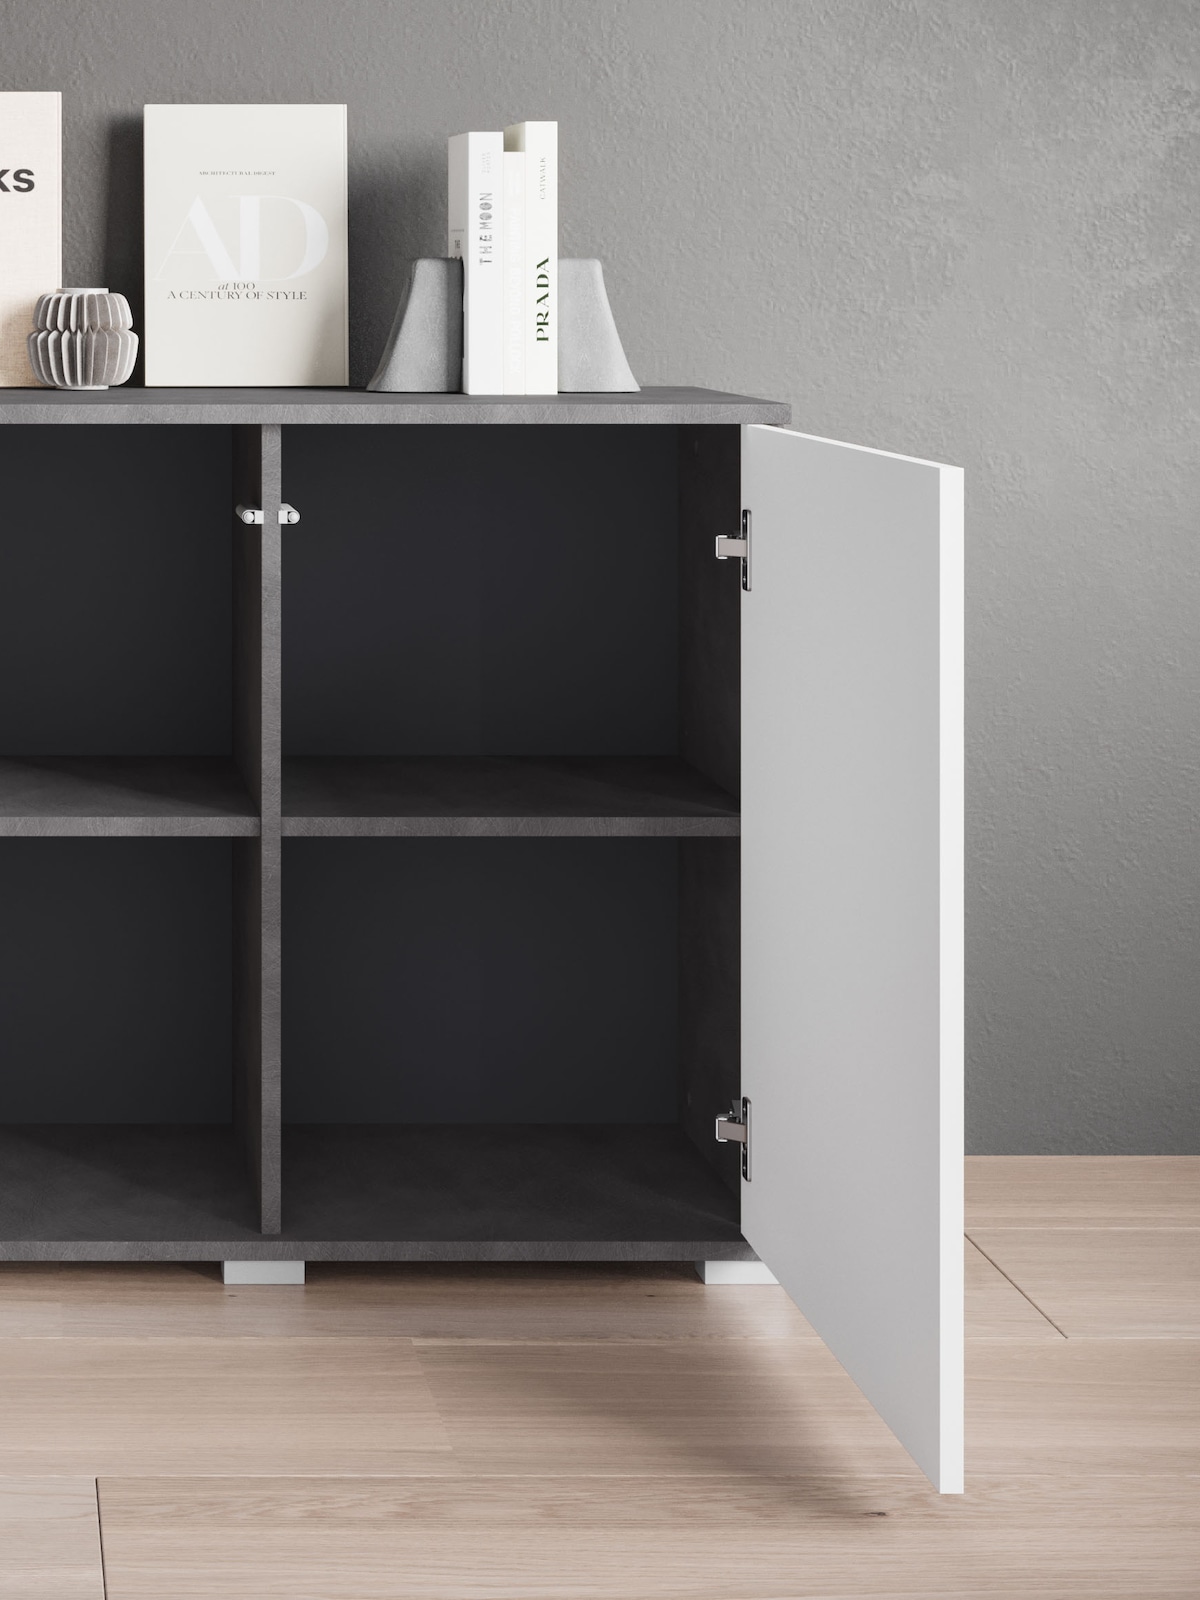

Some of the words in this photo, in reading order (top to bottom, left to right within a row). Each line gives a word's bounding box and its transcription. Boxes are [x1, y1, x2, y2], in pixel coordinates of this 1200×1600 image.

[539, 157, 547, 200] CATWALK
[479, 192, 492, 230] MOON
[153, 194, 329, 282] AD
[479, 234, 492, 266] THE
[167, 291, 176, 300] A
[179, 291, 243, 300] CENTURY
[246, 291, 264, 300] OF
[267, 291, 308, 300] STYLE
[218, 282, 229, 291] at
[233, 282, 256, 291] 100
[536, 257, 550, 342] PRADA
